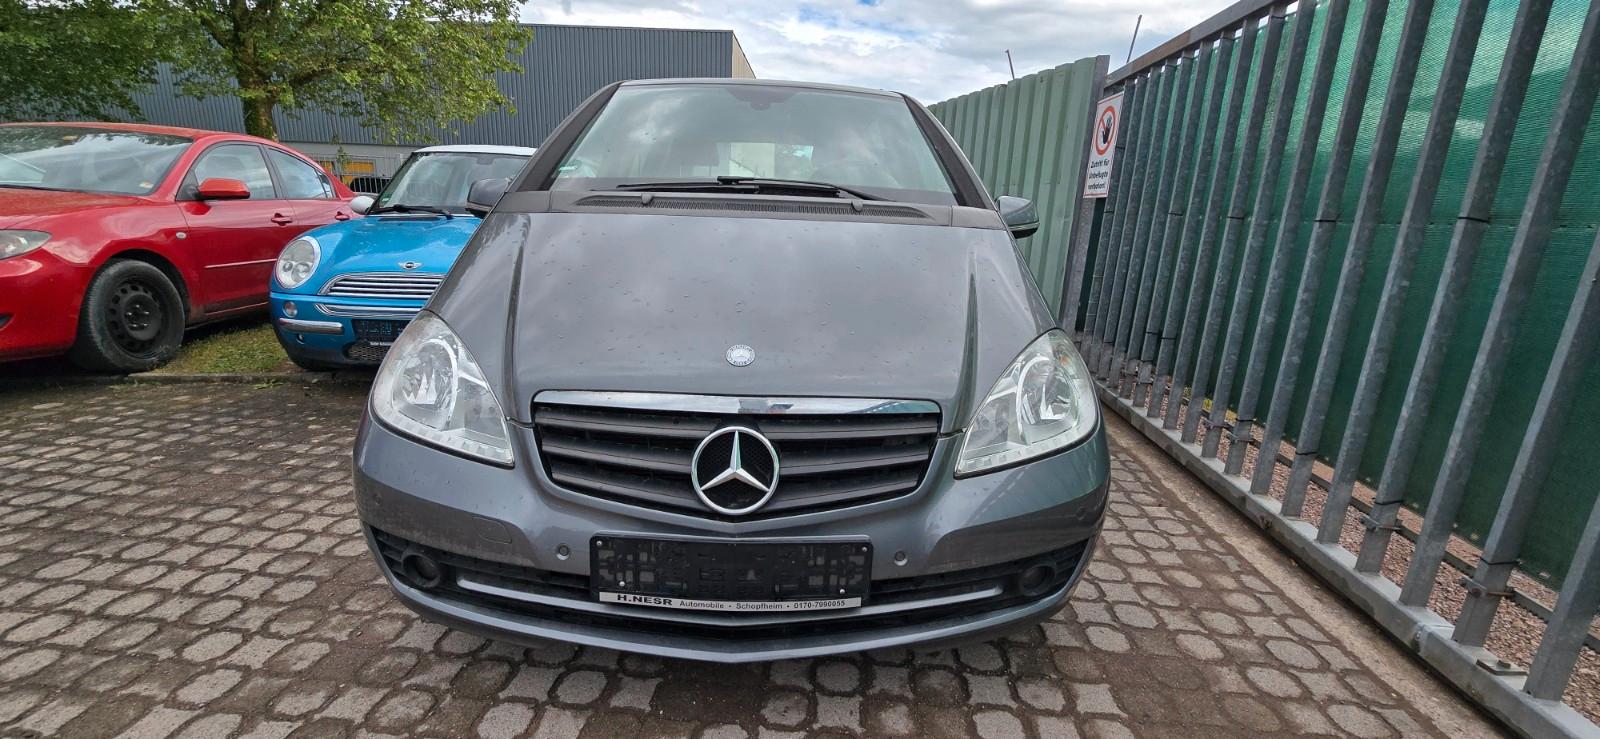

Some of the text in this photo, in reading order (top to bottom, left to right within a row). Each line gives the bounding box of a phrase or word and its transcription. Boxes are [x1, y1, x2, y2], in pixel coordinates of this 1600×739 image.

[1089, 171, 1109, 179] Unbefugte
[617, 594, 673, 606] H.NESR
[680, 600, 724, 609] Automobile
[736, 602, 783, 610] Schopfheim
